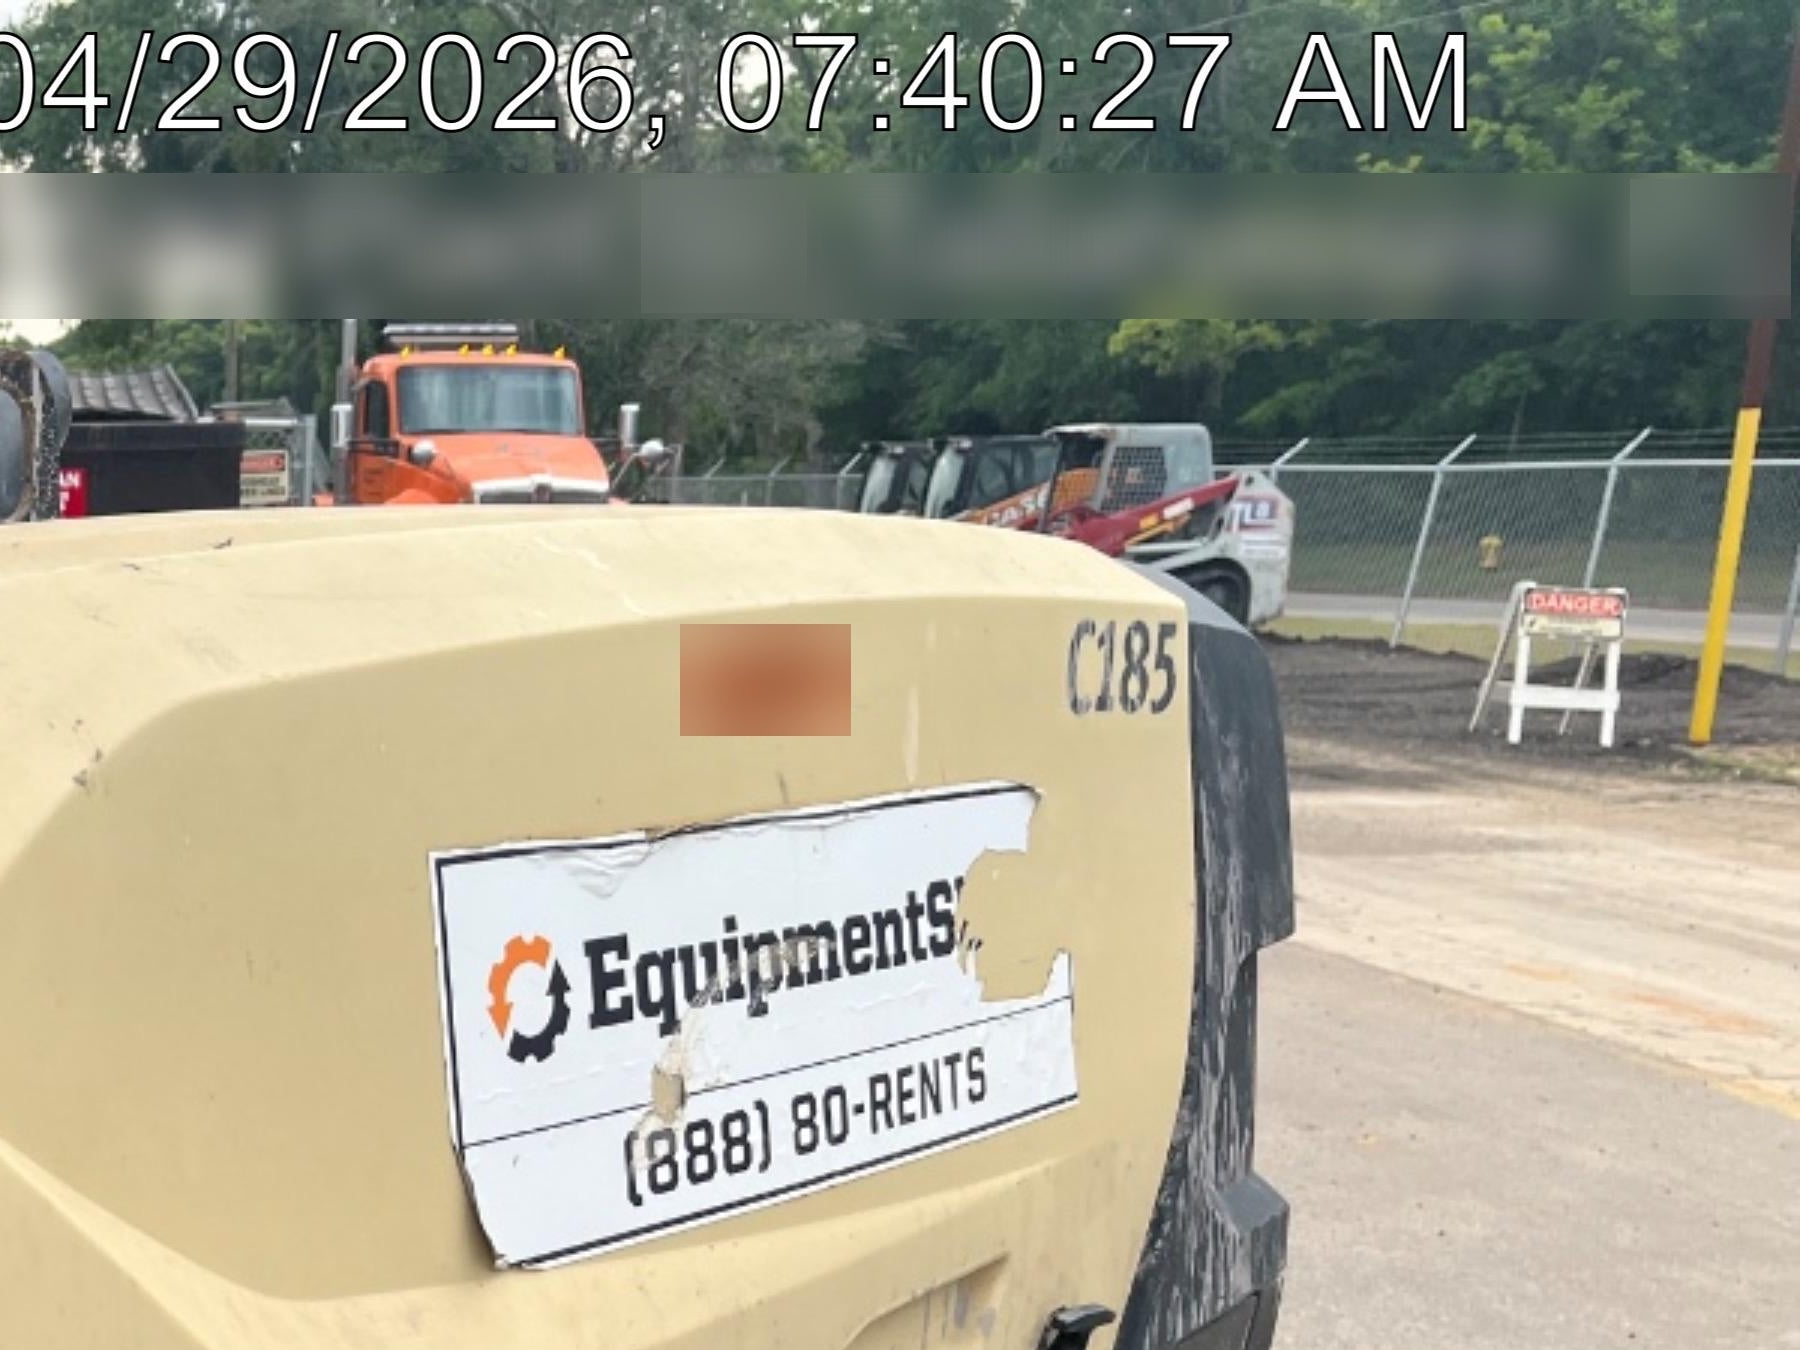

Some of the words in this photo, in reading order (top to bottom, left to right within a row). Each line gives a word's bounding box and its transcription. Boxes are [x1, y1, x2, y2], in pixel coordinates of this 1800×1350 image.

[1068, 620, 1176, 714] C185
[1526, 592, 1623, 617] DANGER
[584, 876, 966, 1037] EquipmentS
[624, 1099, 771, 1206] (888)
[791, 1046, 987, 1155] 80-RENTS
